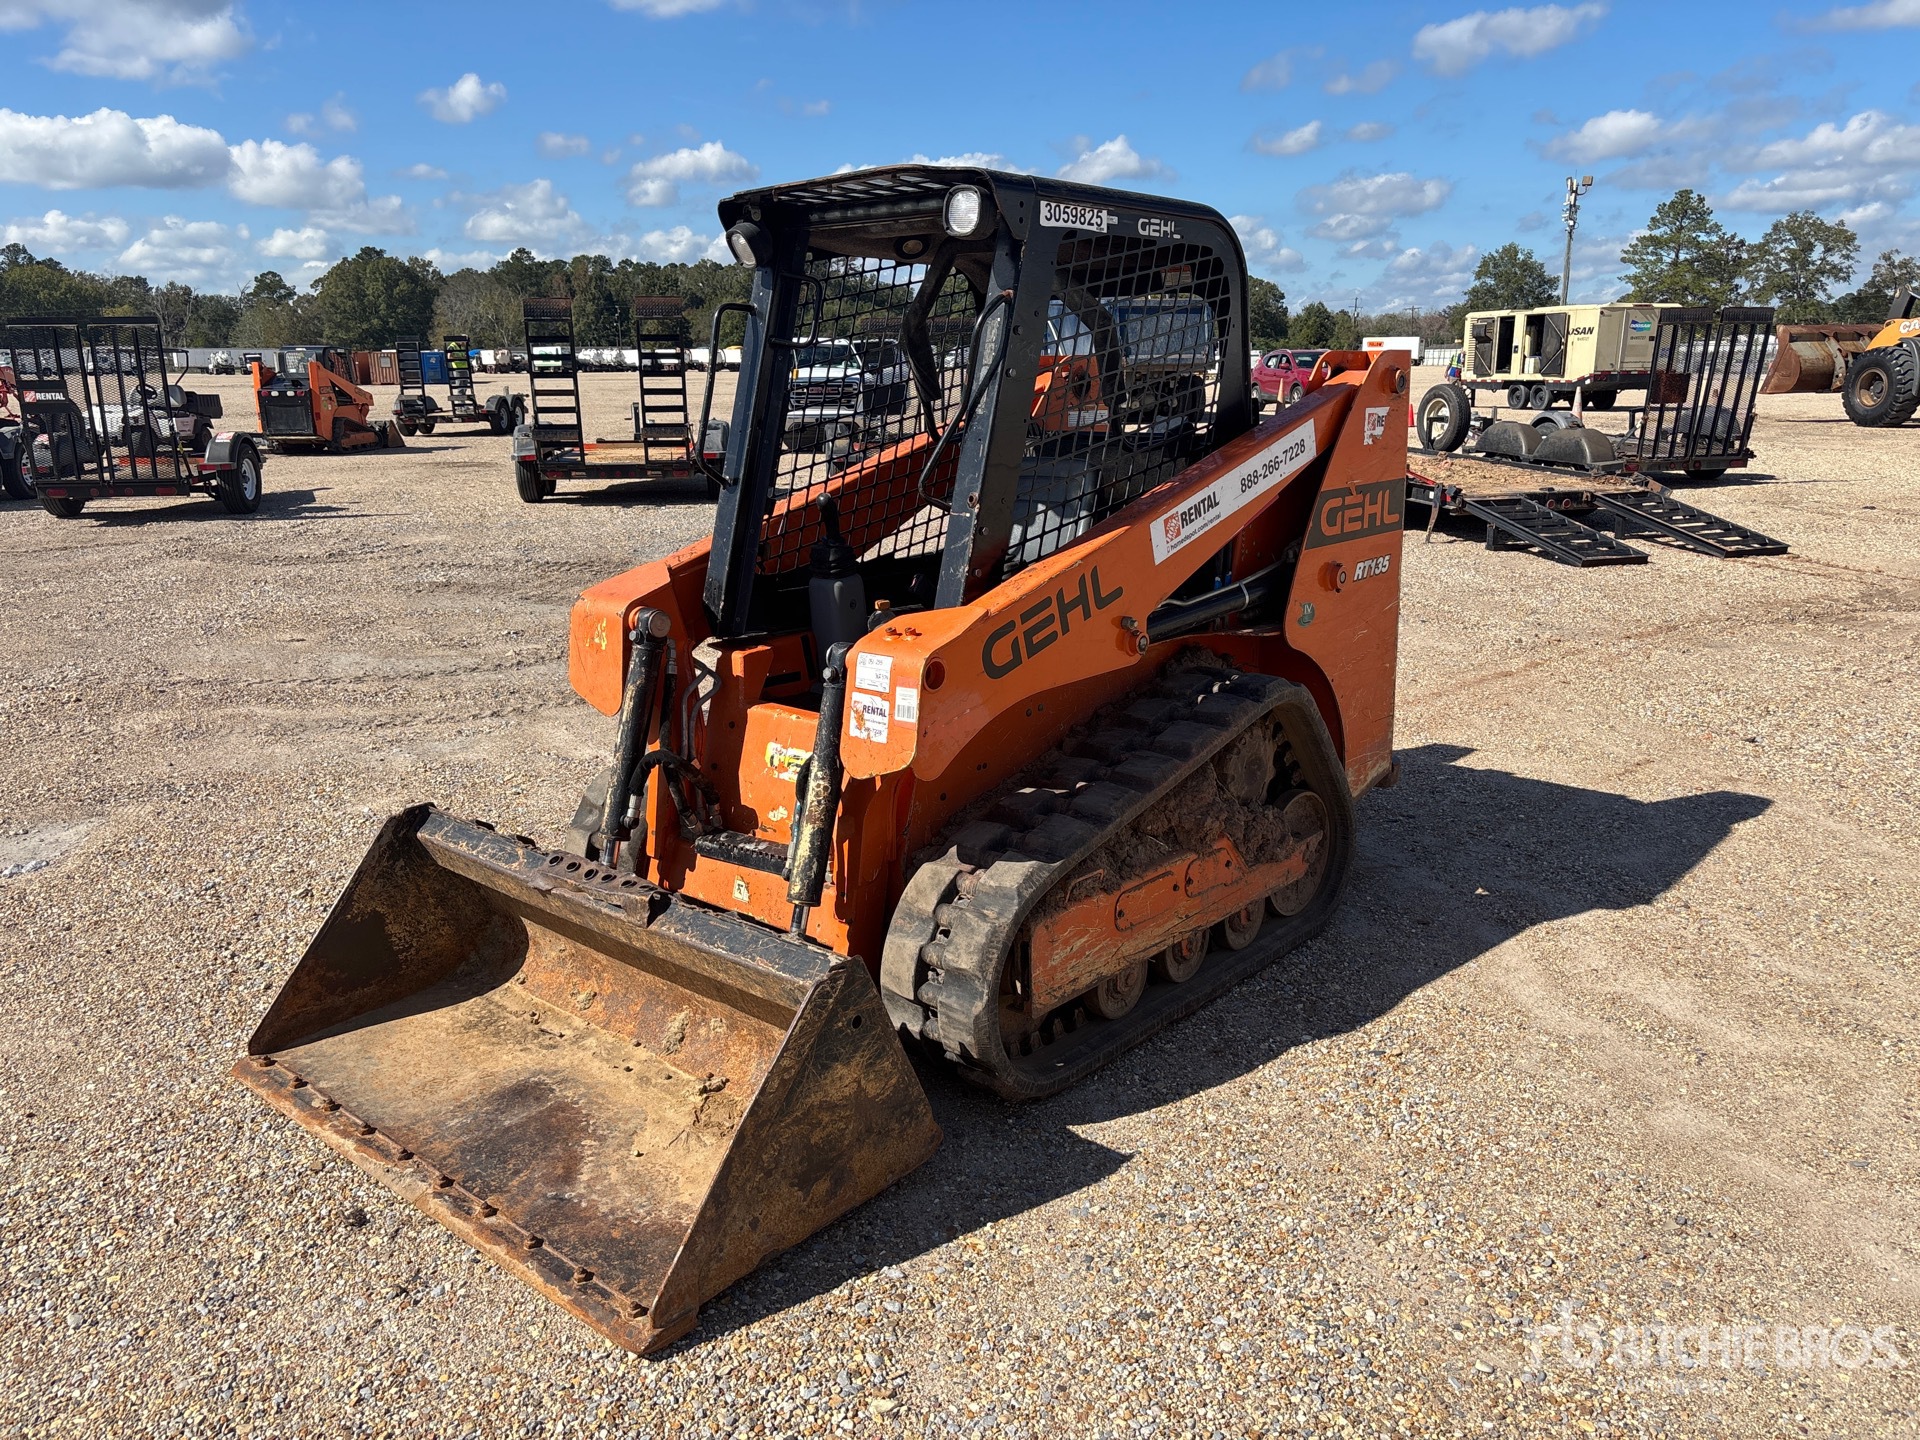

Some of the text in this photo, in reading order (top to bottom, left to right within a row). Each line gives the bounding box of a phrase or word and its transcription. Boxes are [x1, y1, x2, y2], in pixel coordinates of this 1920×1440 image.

[1044, 202, 1103, 227] 3059825
[1137, 218, 1181, 239] GEHL
[36, 392, 66, 401] RENTAL
[1240, 438, 1306, 493] 888-266-7228
[1179, 490, 1221, 530] RENTAL
[1320, 489, 1400, 536] GEHL
[1353, 554, 1391, 582] RT135
[981, 565, 1124, 680] GEHL
[862, 704, 887, 718] RENTAL
